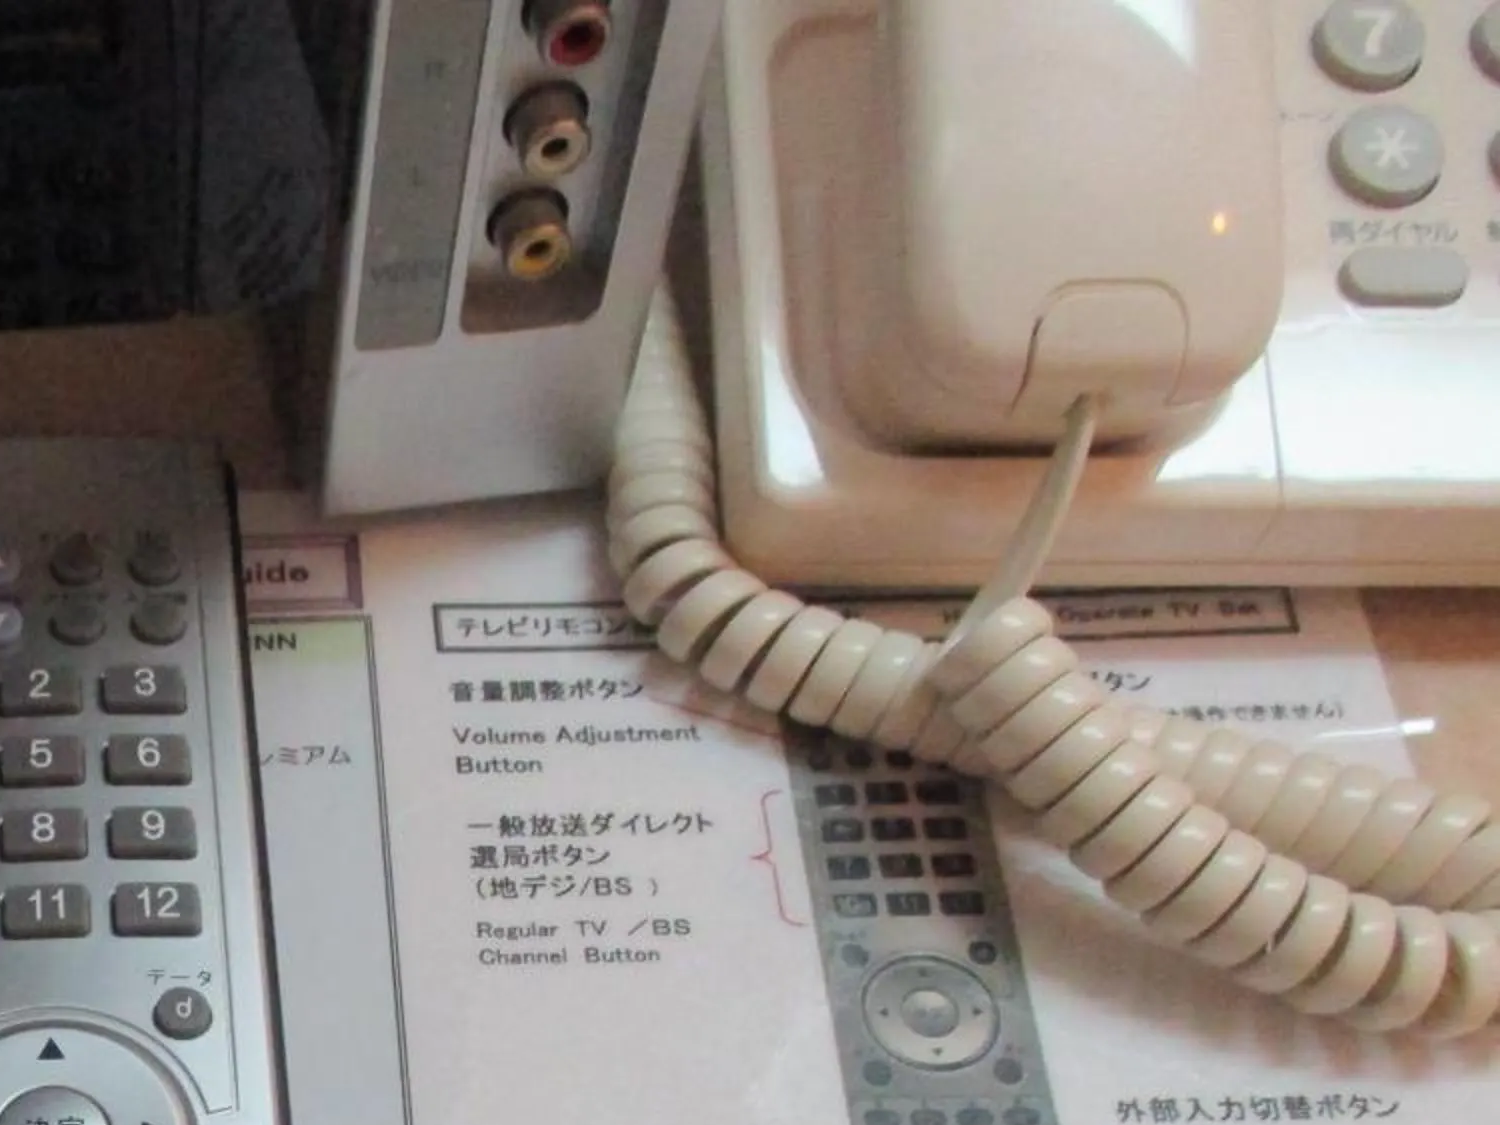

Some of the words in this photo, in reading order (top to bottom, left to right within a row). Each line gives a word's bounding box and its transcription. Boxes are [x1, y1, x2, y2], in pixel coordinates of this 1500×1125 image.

[1352, 9, 1395, 57] 7
[29, 669, 52, 699] 2
[134, 668, 156, 696] 3
[450, 679, 644, 704] 音量調整ボタン
[452, 727, 546, 745] Volume
[556, 724, 701, 746] Adjustment
[29, 739, 52, 768] 5
[137, 738, 161, 767] 6
[456, 757, 543, 774] Button
[31, 813, 55, 842] 8
[141, 810, 165, 840] 9
[467, 813, 714, 838] 一般放送ダイレクト
[469, 845, 611, 870] 選局ボタン
[28, 890, 66, 919] 11
[137, 888, 181, 918] 12
[476, 921, 560, 942] Regular
[576, 921, 607, 937] TV
[479, 947, 567, 966] Channel
[584, 946, 660, 964] Button
[147, 967, 212, 985] データ
[175, 997, 192, 1019] d
[1116, 1094, 1400, 1124] 外部入力切替ボタン
